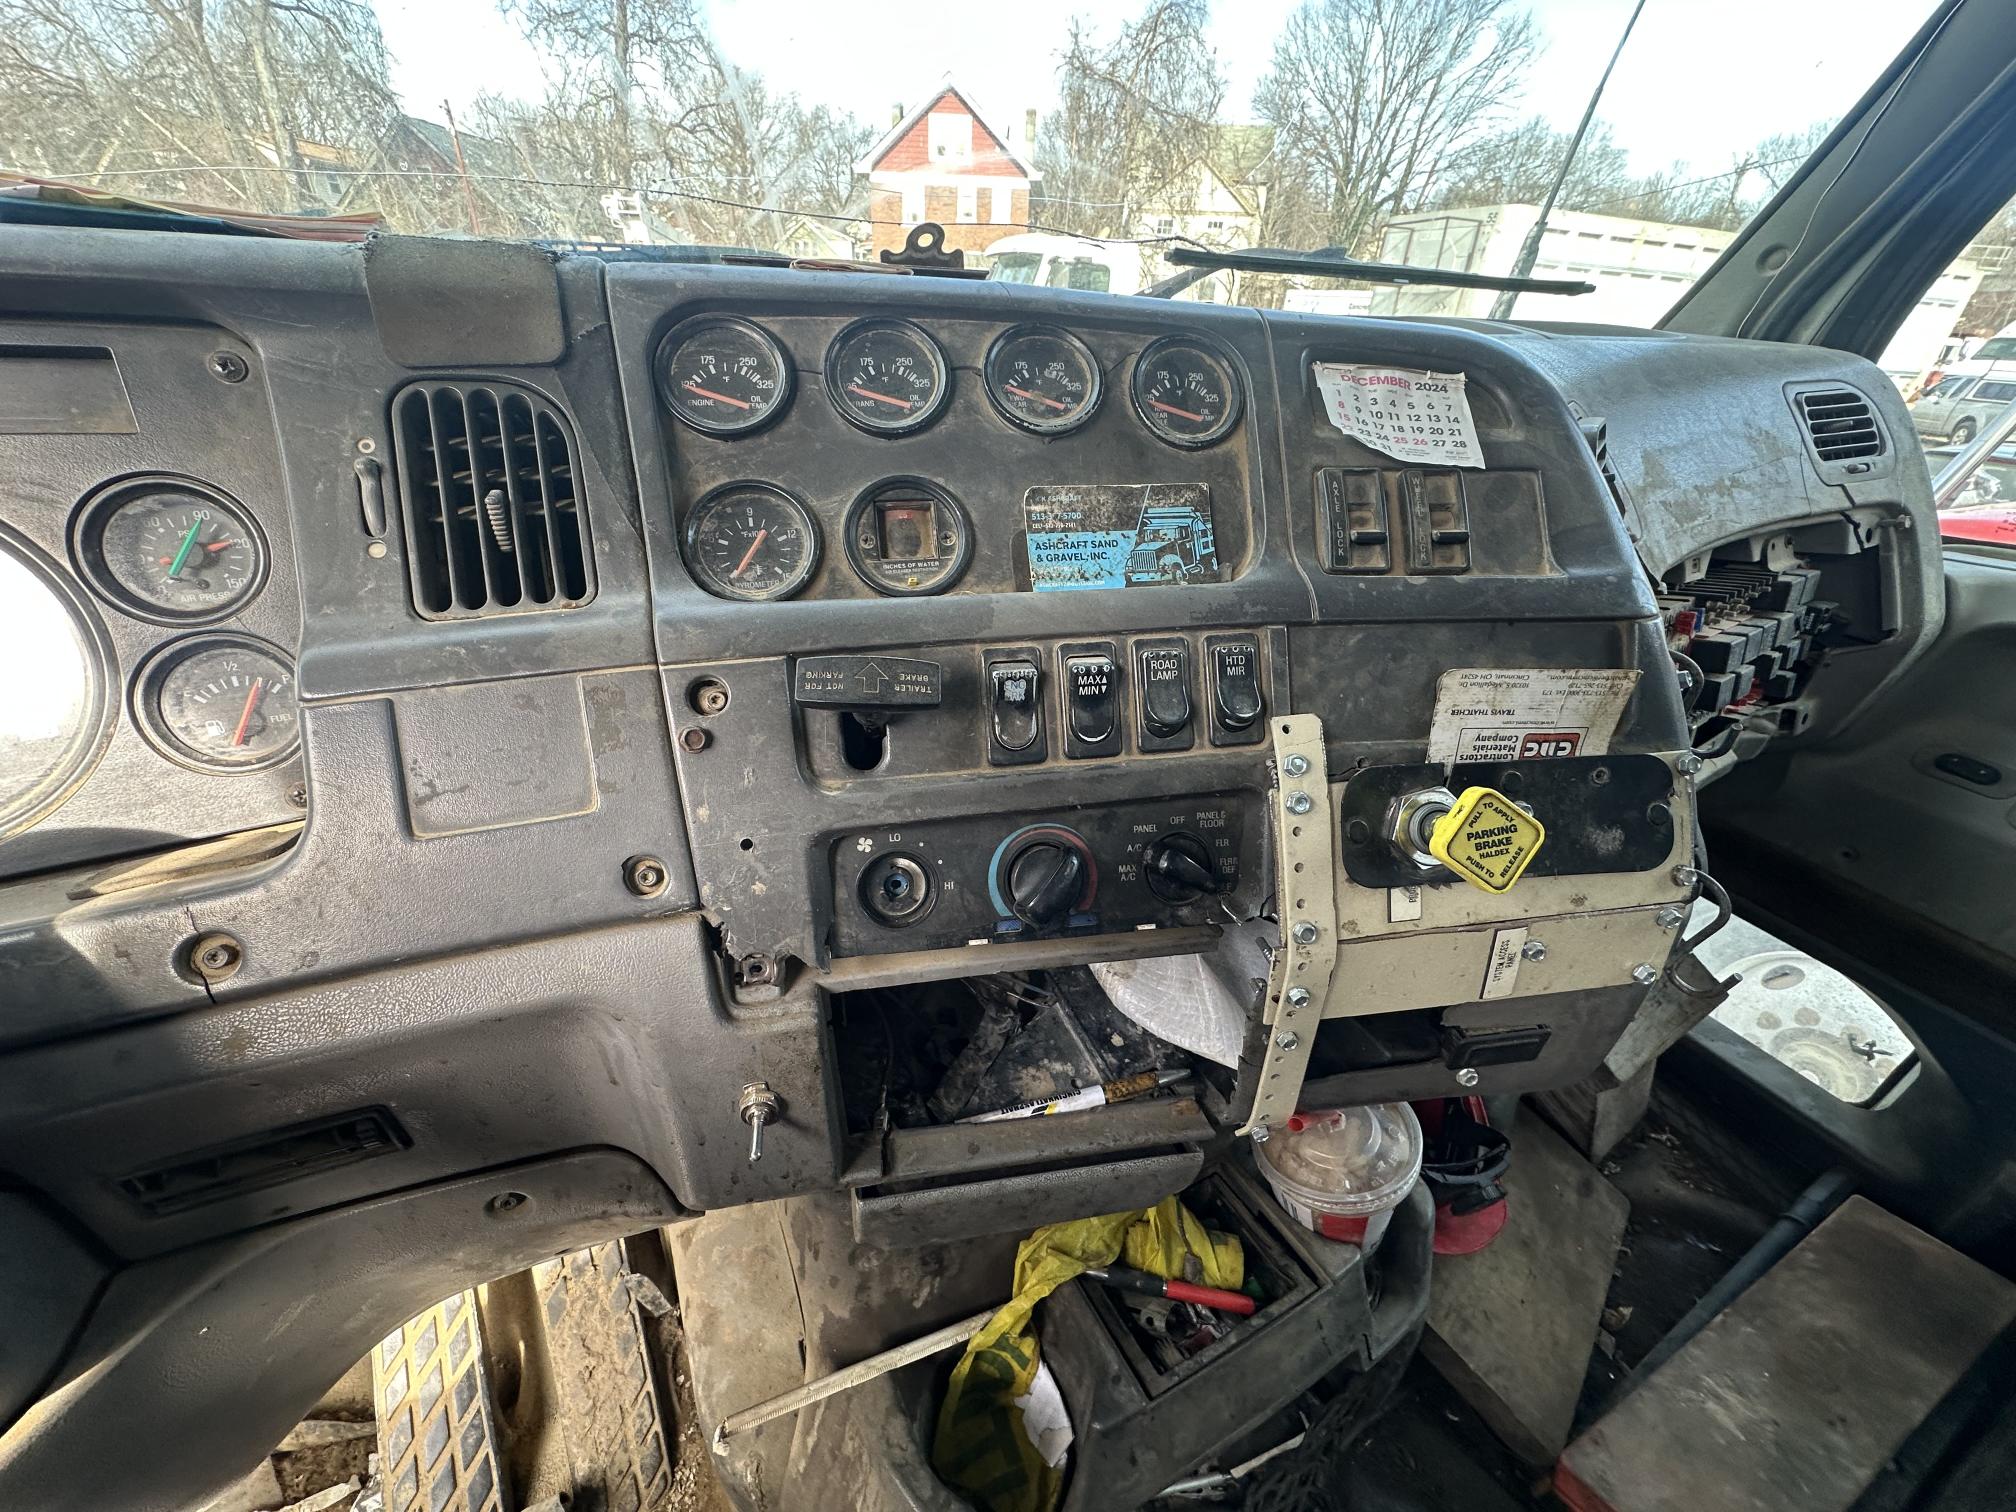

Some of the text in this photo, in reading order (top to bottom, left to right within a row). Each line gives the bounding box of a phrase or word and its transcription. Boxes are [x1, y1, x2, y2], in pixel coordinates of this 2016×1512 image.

[701, 355, 715, 364] 175
[739, 357, 756, 365] 250
[860, 358, 873, 366] 175
[1157, 371, 1169, 379] 175
[1189, 373, 1203, 381] 250
[757, 380, 773, 388] 325
[914, 379, 930, 387] 325
[1341, 375, 1449, 393] DECEMBER 2024
[1205, 394, 1218, 402] 325
[1353, 394, 1360, 403] 2
[1389, 400, 1396, 408] 4
[1338, 401, 1345, 409] 8
[1355, 406, 1362, 414] 9
[1369, 411, 1383, 419] 10
[1388, 412, 1400, 420] 11
[1445, 416, 1460, 424] 14
[1337, 412, 1351, 422] 15
[1356, 417, 1368, 426] 16
[1372, 422, 1385, 430] 17
[1390, 425, 1405, 433] 18
[1410, 426, 1424, 434] 19
[1448, 428, 1462, 436] 21
[1357, 428, 1372, 437] 23
[1375, 433, 1390, 442] 24
[1413, 438, 1428, 446] 26
[1452, 440, 1467, 448] 28
[1332, 481, 1341, 512] AXLE
[193, 510, 210, 520] 90
[746, 507, 753, 516] 9
[1031, 512, 1082, 520] 513-37-5700
[1411, 477, 1427, 560] WHEEL LOCK
[787, 530, 796, 538] 12
[1035, 540, 1118, 550] ASHCRAFT SAND
[1046, 553, 1089, 562] GRAVEL,
[1091, 552, 1110, 560] INC.
[735, 580, 780, 588] PYROMETER
[180, 593, 196, 602] AIR
[1150, 660, 1178, 670] ROAD
[1226, 656, 1245, 666] HTD
[223, 661, 241, 671] 1/2
[1150, 671, 1178, 680] LAMP
[1226, 666, 1245, 676] MIR
[900, 673, 929, 682] BRAKE
[1078, 675, 1101, 686] MAX
[894, 684, 932, 693] TRAILER
[1078, 686, 1099, 696] MIN
[270, 714, 294, 723] FUEL
[1475, 733, 1519, 743] Company
[1472, 744, 1517, 752] Materials
[1170, 816, 1185, 824] OFF
[1197, 812, 1220, 820] PANEL
[1469, 811, 1483, 828] PULL
[1493, 806, 1515, 823] APPLY
[1134, 825, 1158, 833] PANEL
[1467, 824, 1518, 841] PARKING
[889, 834, 901, 842] LO
[1127, 844, 1142, 852] A/C
[1474, 837, 1513, 851] BRAKE
[1479, 848, 1510, 859] HALDEX
[1466, 846, 1524, 878] PUSH TO RELEASE
[1118, 864, 1137, 873] MAX
[1120, 873, 1136, 881] A/C
[944, 882, 954, 890] HI
[1493, 939, 1510, 982] SYSTEM ACCESS
[1505, 952, 1516, 968] PANEL
[1036, 1089, 1081, 1105] CINCINNATI
